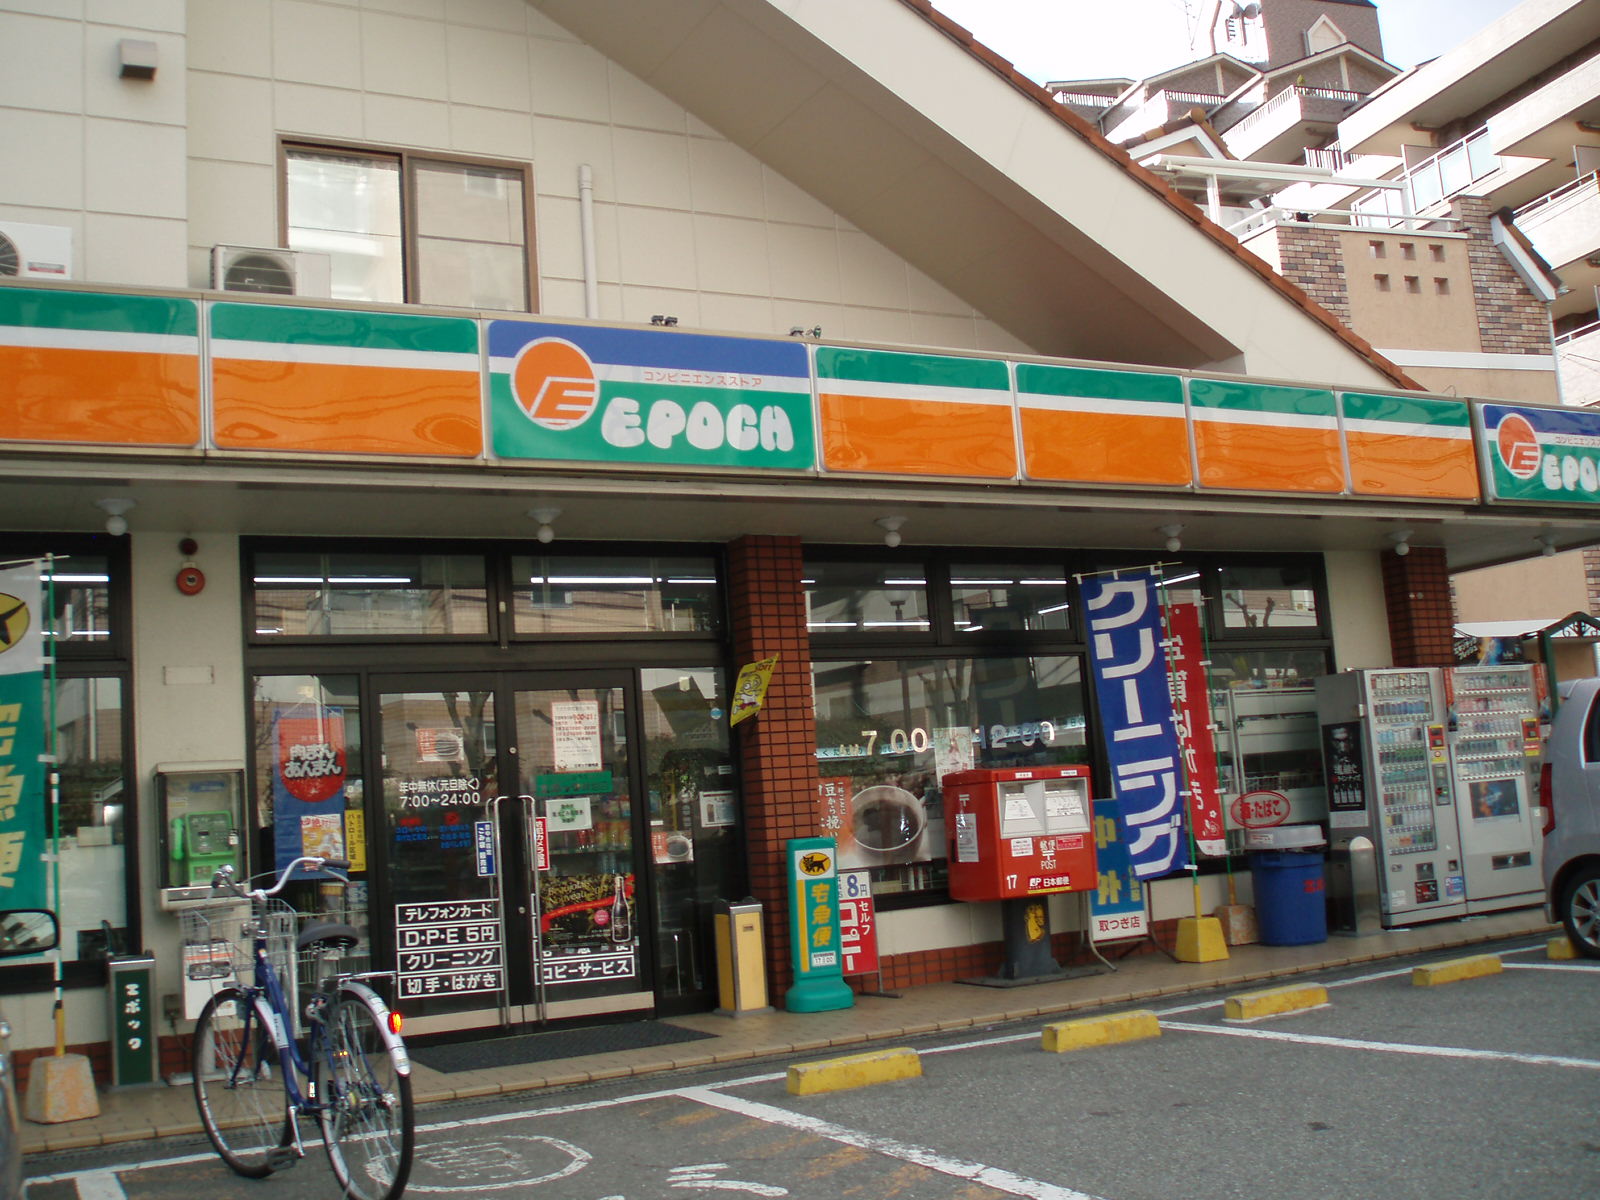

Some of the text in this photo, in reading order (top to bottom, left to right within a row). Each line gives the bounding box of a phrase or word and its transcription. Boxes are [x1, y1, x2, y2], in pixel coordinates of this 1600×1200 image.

[643, 369, 764, 388] コンビニエンスストア
[601, 396, 795, 452] EPOCH
[1541, 453, 1600, 493] EPO
[1087, 579, 1182, 877] クリーニング
[289, 743, 336, 761] 肉まん
[284, 760, 342, 779] あんまん
[1040, 859, 1057, 870] POST
[1006, 874, 1018, 890] 17
[404, 903, 493, 922] テレフォンカード
[811, 882, 833, 948] 宅急便
[858, 900, 872, 936] セルフ
[1099, 915, 1141, 932] 取つぎ店
[465, 925, 495, 942] 5円
[839, 901, 862, 971] コピー
[406, 948, 496, 971] クリーニング
[542, 959, 630, 980] コピーサービス
[406, 972, 497, 995] 切手・はがき
[124, 982, 143, 1051] エポック
